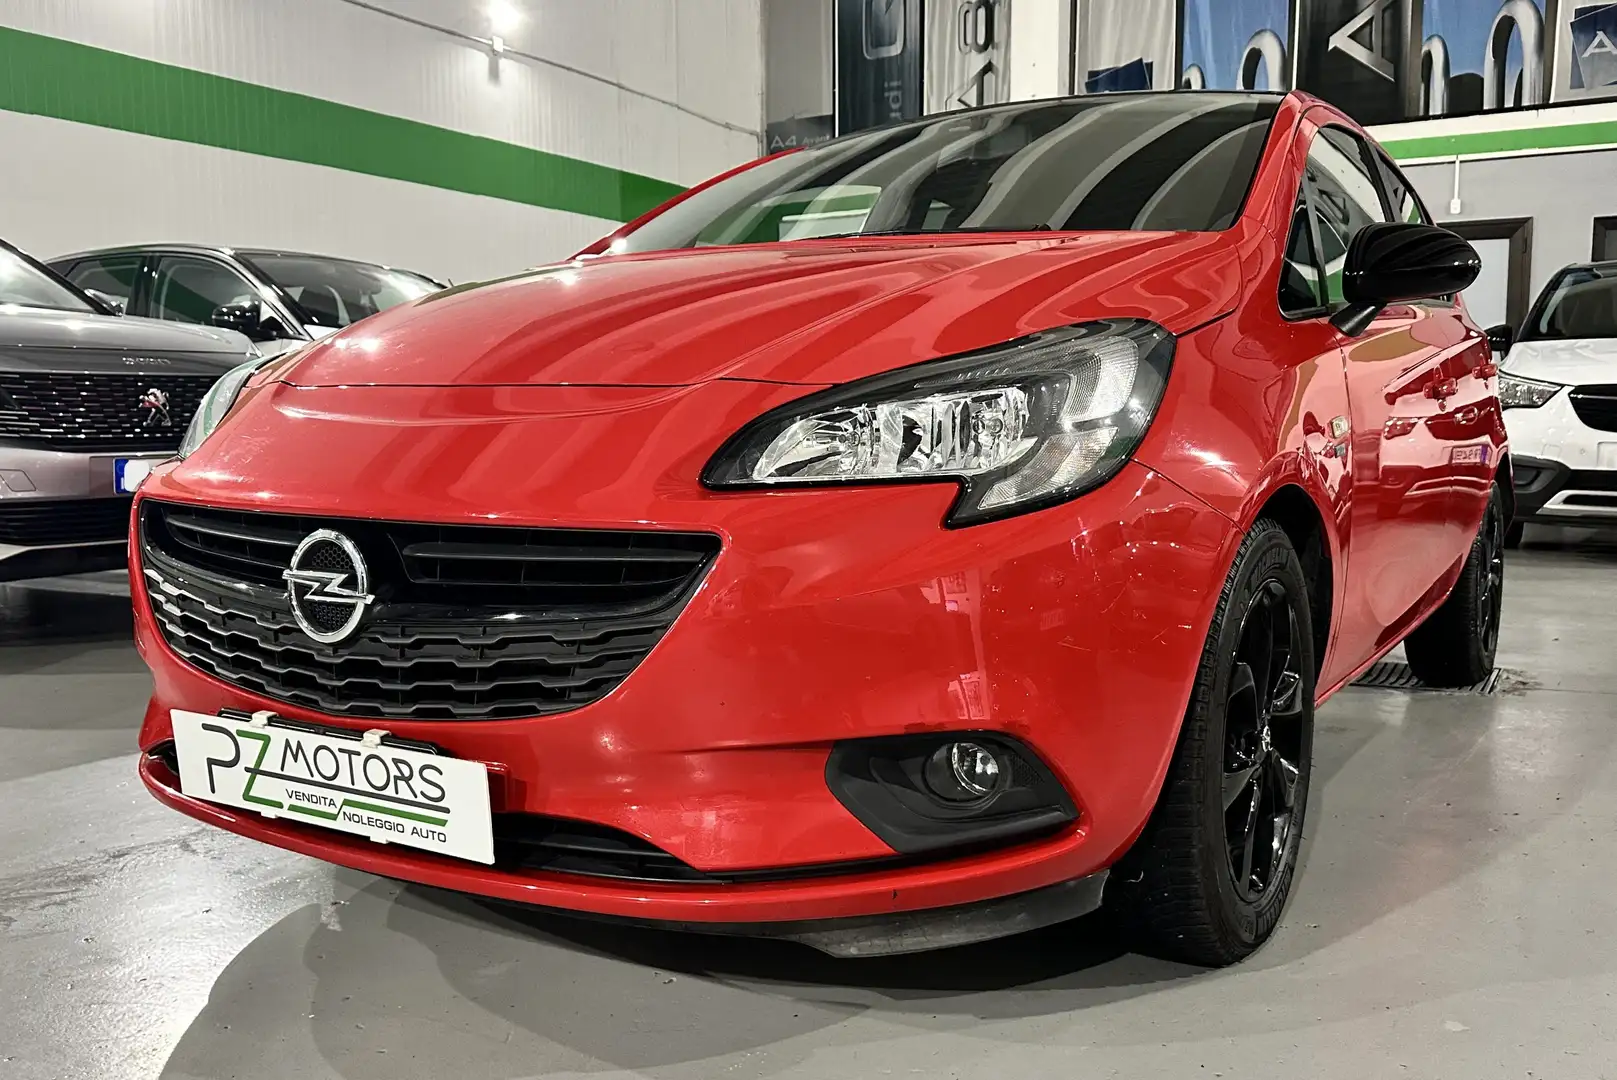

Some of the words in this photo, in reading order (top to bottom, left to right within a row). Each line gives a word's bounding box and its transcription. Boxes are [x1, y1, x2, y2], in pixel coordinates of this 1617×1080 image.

[770, 134, 797, 150] A4
[280, 738, 446, 802] MOTORS
[285, 788, 337, 809] VENDITA
[342, 810, 405, 834] NOLEGGIO
[410, 826, 447, 844] AUTO
